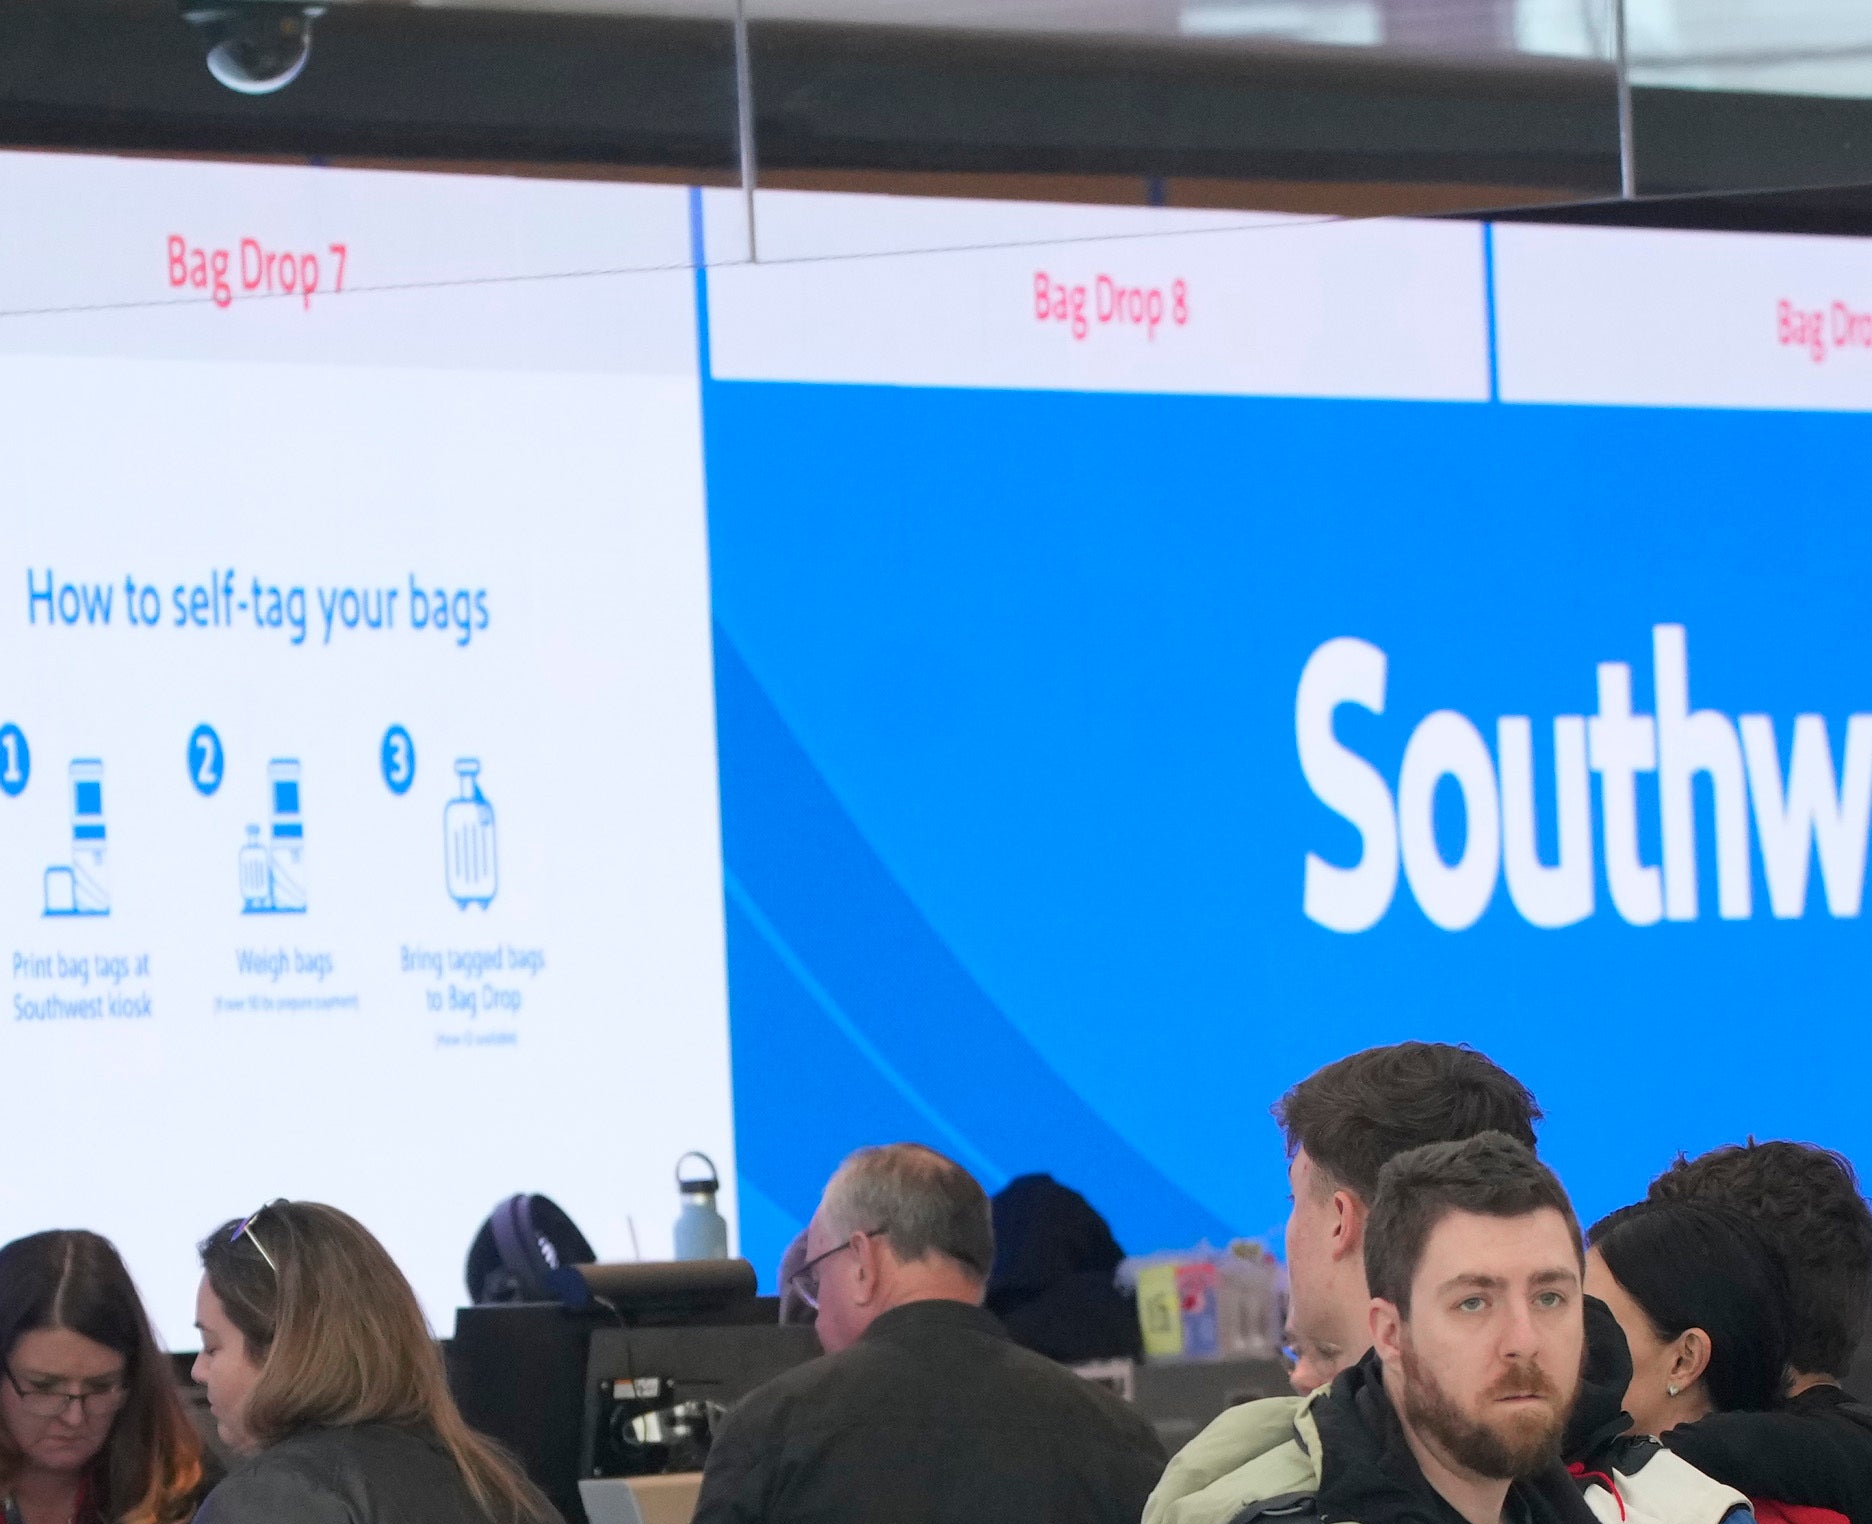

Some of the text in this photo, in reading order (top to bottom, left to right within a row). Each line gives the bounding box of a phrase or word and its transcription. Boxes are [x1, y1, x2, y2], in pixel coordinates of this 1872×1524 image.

[168, 234, 347, 310] Bag Drop 7
[1034, 271, 1187, 341] Bag Drop 8
[1778, 299, 1824, 363] Bag
[27, 567, 489, 647] How to self-tag your bags
[13, 950, 149, 986] Print bag tags at
[235, 947, 334, 983] Weigh bags
[401, 943, 545, 980] Bring tagged bags
[14, 990, 153, 1021] Southwest kiosk
[427, 983, 521, 1019] to Bag Drop
